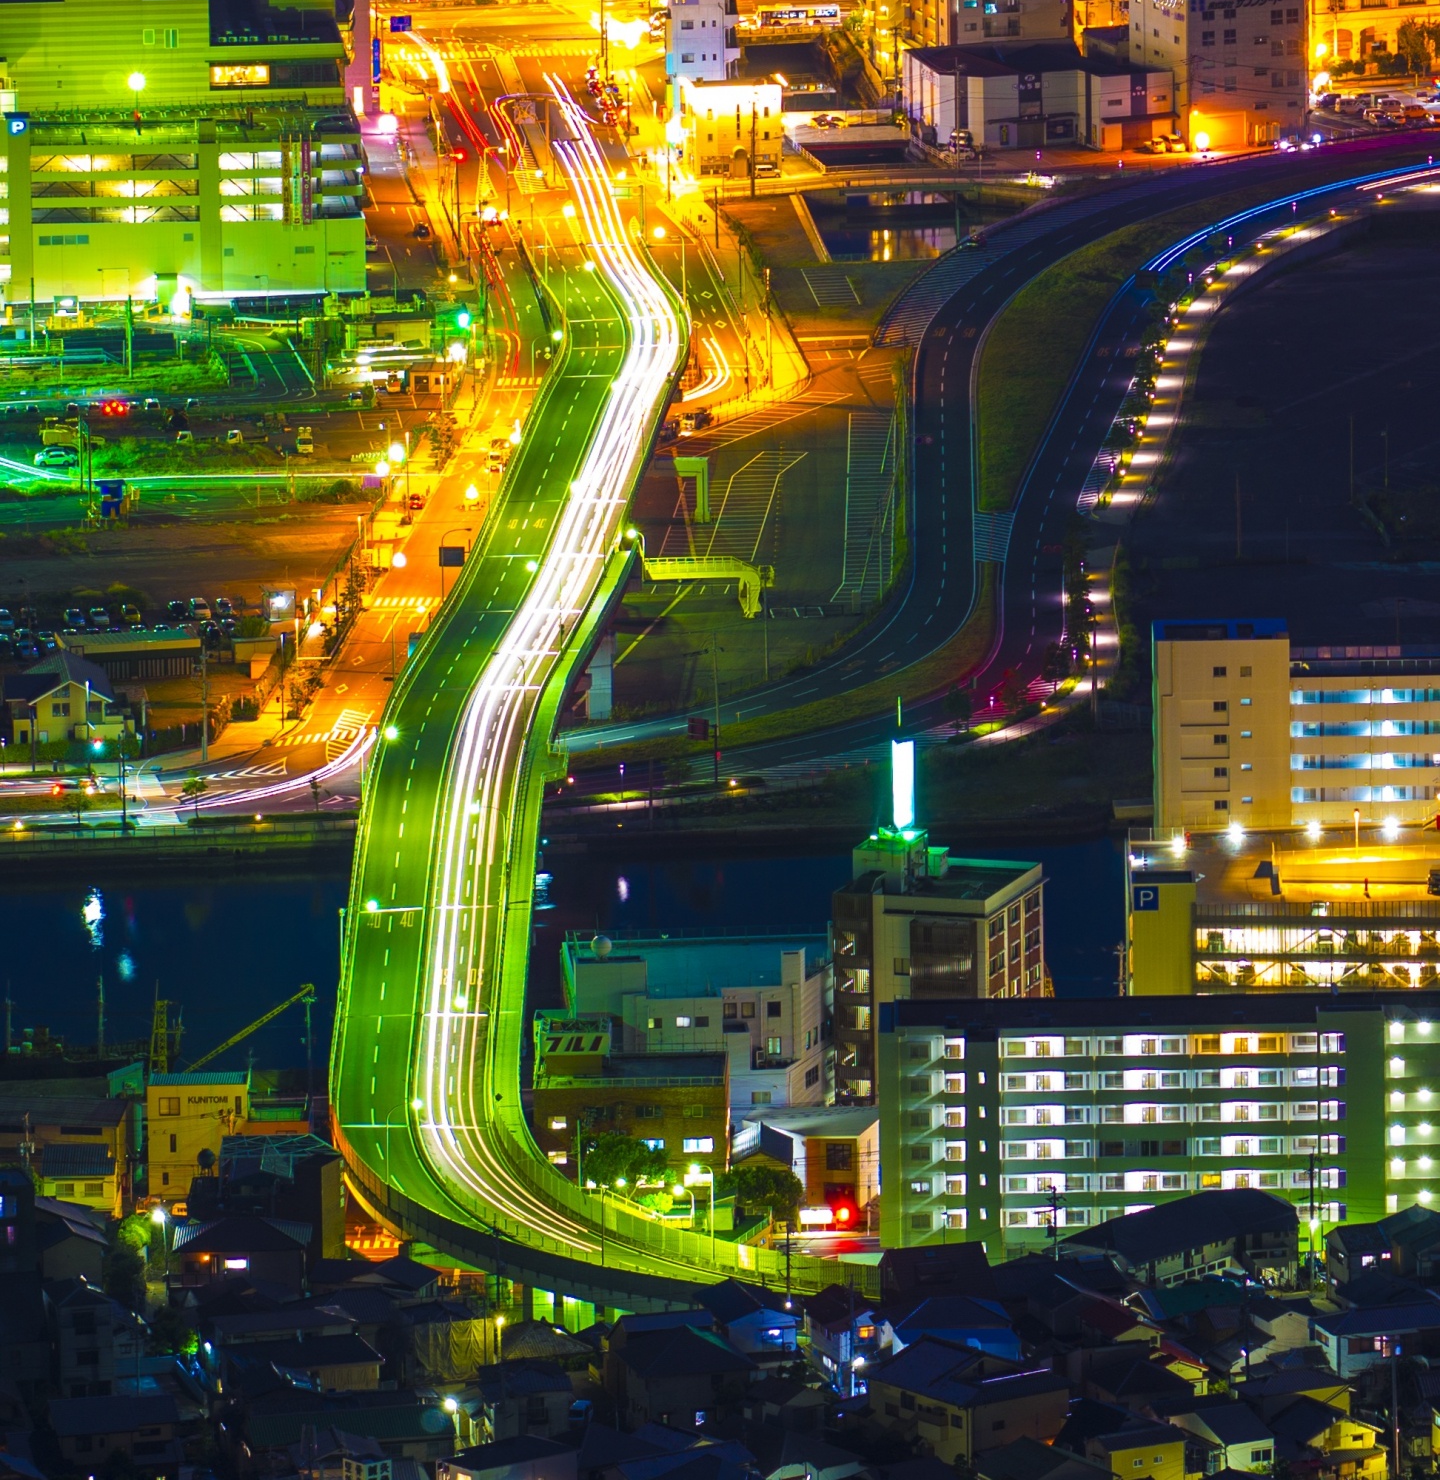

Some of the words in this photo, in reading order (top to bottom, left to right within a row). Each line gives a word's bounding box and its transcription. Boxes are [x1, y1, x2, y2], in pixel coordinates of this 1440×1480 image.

[12, 121, 25, 134] P
[1140, 890, 1154, 907] P
[400, 911, 414, 928] 40
[188, 1096, 228, 1104] KUNITOMI
